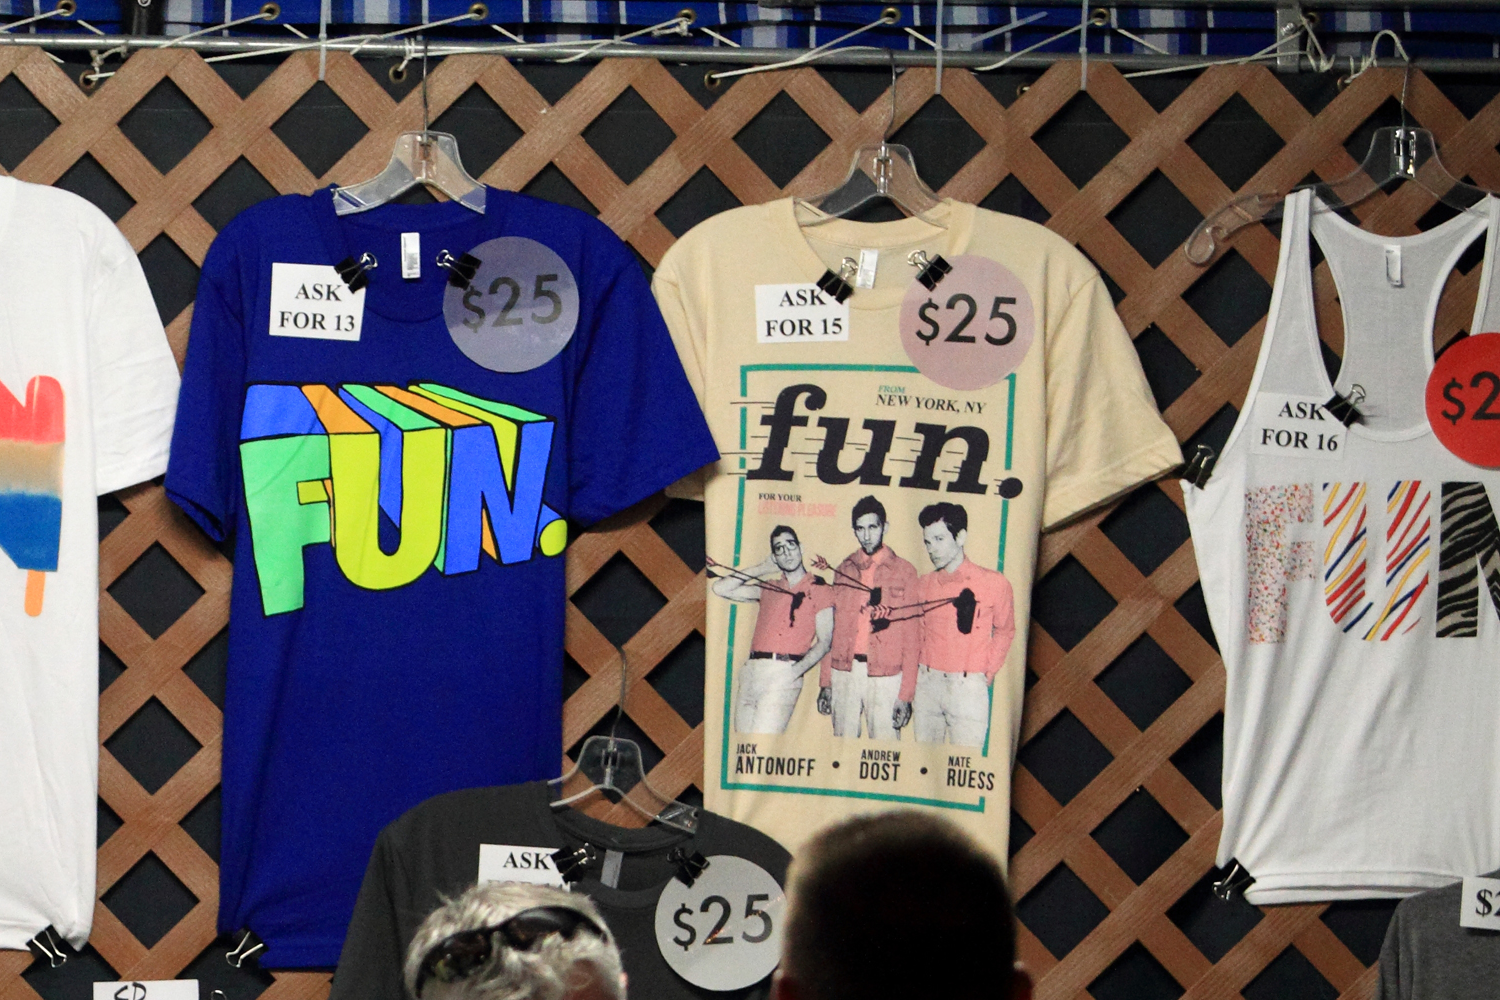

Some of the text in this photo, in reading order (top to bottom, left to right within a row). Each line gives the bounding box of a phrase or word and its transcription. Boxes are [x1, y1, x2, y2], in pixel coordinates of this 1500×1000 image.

[295, 283, 342, 301] ASK
[779, 289, 824, 306] ASK
[462, 273, 563, 333] $25
[279, 311, 356, 332] FOR 13
[766, 318, 843, 337] FOR 15
[915, 293, 1018, 348] $25
[878, 385, 906, 394] FROM
[876, 394, 987, 414] NEW YORK, NY
[1278, 400, 1325, 421] ASK
[746, 384, 1024, 499] fun.
[1261, 428, 1338, 451] FOR 16
[239, 380, 568, 618] FUN.
[759, 493, 802, 502] FOR YOUR
[736, 743, 757, 755] JACK
[860, 749, 901, 762] ANDREW
[948, 755, 971, 768] NATE
[735, 756, 995, 791] ANTONOFF DOST RUESS
[503, 851, 551, 870] ASK
[672, 893, 773, 951] $25
